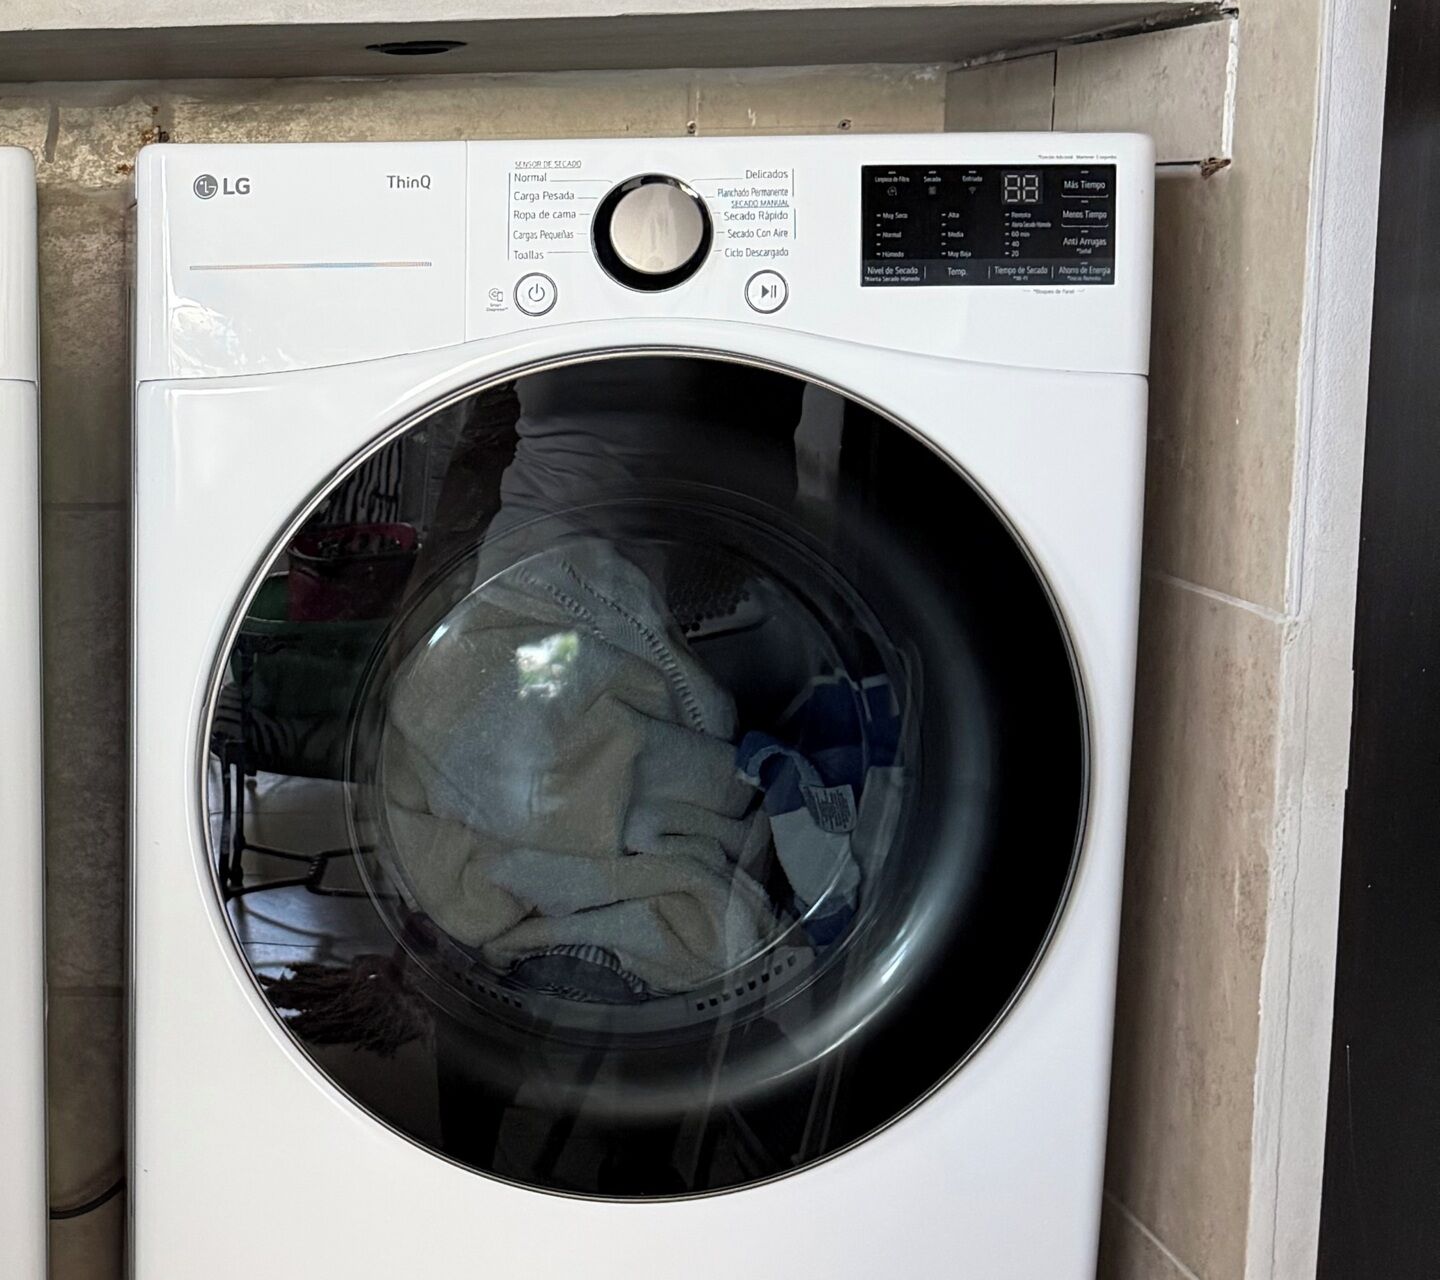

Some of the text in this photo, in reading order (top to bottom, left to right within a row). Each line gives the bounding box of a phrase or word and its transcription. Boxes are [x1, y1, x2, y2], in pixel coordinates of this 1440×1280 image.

[514, 159, 582, 169] SENSOR DE SECADO
[514, 172, 547, 182] Normal
[745, 169, 789, 180] Delicados
[222, 177, 251, 195] LG
[386, 174, 431, 190] ThinQ
[1063, 180, 1106, 190] Más Tiempo
[513, 190, 575, 203] Carga Pesada
[717, 187, 789, 197] Planchado Permanente
[731, 199, 789, 208] SECADO MANUAL
[513, 210, 577, 221] Ropa de cama
[724, 210, 789, 222] Secado Rápido
[1062, 210, 1107, 220] Menos Tiempo
[513, 229, 574, 241] Cargas Pequeñas
[727, 228, 789, 239] Secado Con Aire
[1062, 237, 1107, 248] Anti Arrugas
[514, 250, 544, 260] Toallas
[724, 247, 789, 259] Ciclo Descargado
[867, 266, 918, 275] Nivel de Secado
[994, 266, 1048, 276] Tiempo de Secado
[1059, 265, 1111, 276] Ahorro de Energía
